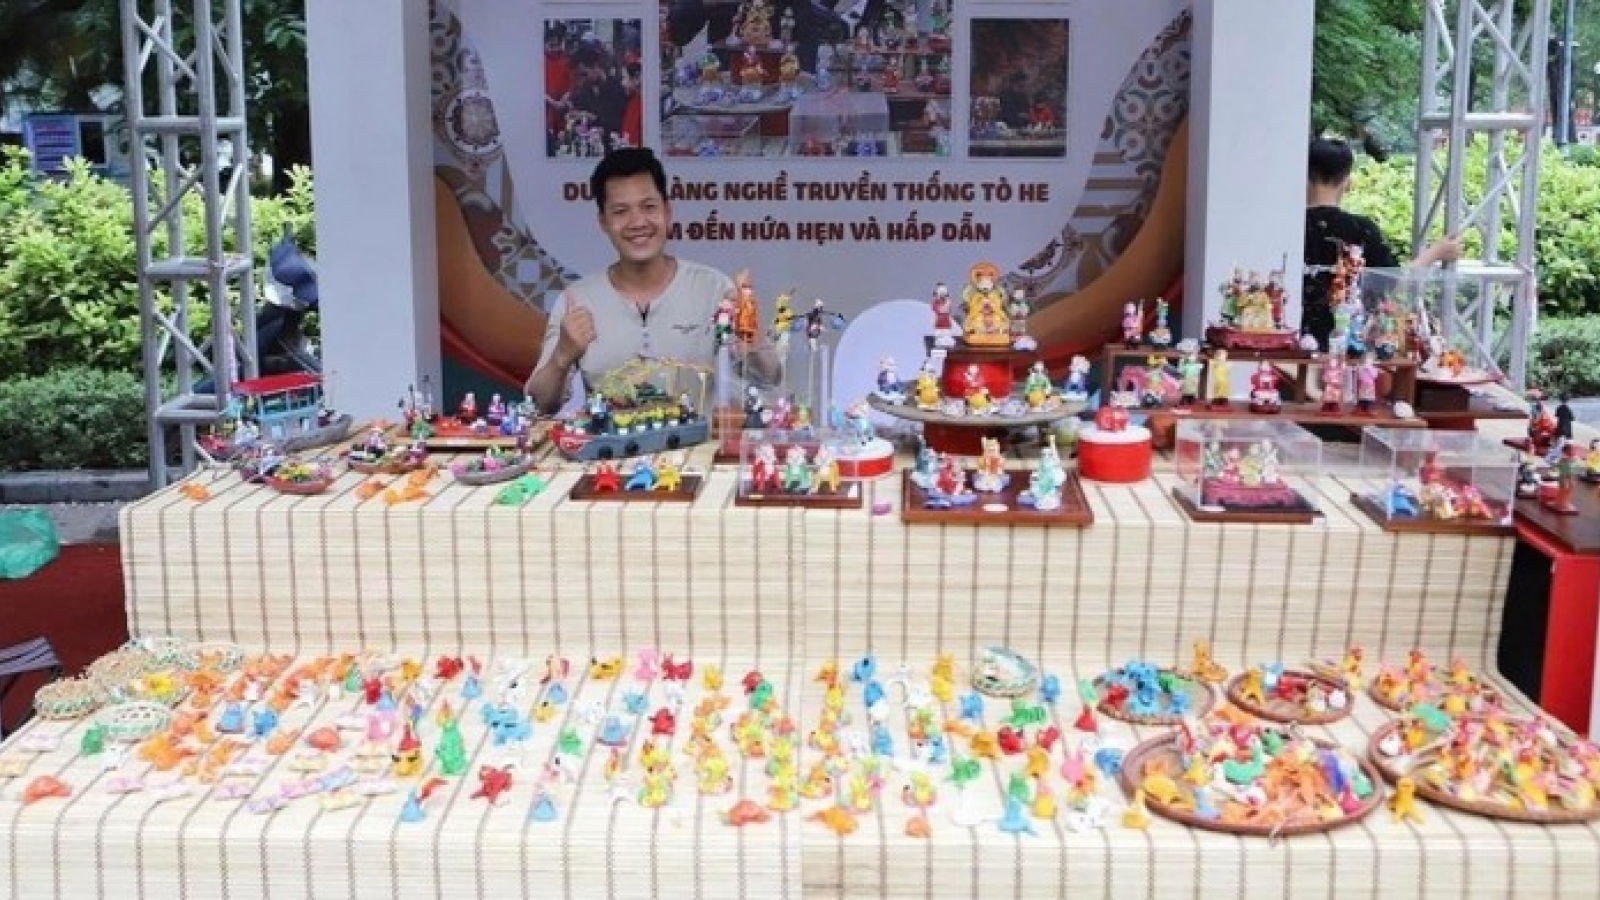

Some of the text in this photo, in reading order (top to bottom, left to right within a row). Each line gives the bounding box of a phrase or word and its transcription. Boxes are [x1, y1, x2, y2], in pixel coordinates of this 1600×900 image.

[666, 175, 719, 201] ÀNG
[724, 169, 788, 201] NGHỀ
[793, 169, 887, 201] TRUYỀN
[893, 169, 975, 201] THỐNG
[981, 176, 1012, 202] TÒ
[1019, 183, 1049, 202] HE
[686, 208, 735, 240] ĐẾN
[742, 215, 790, 240] HỨA
[797, 222, 844, 246] HẸN
[850, 215, 881, 241] VÀ
[887, 209, 936, 242] HẤP
[942, 211, 991, 242] DẪN
